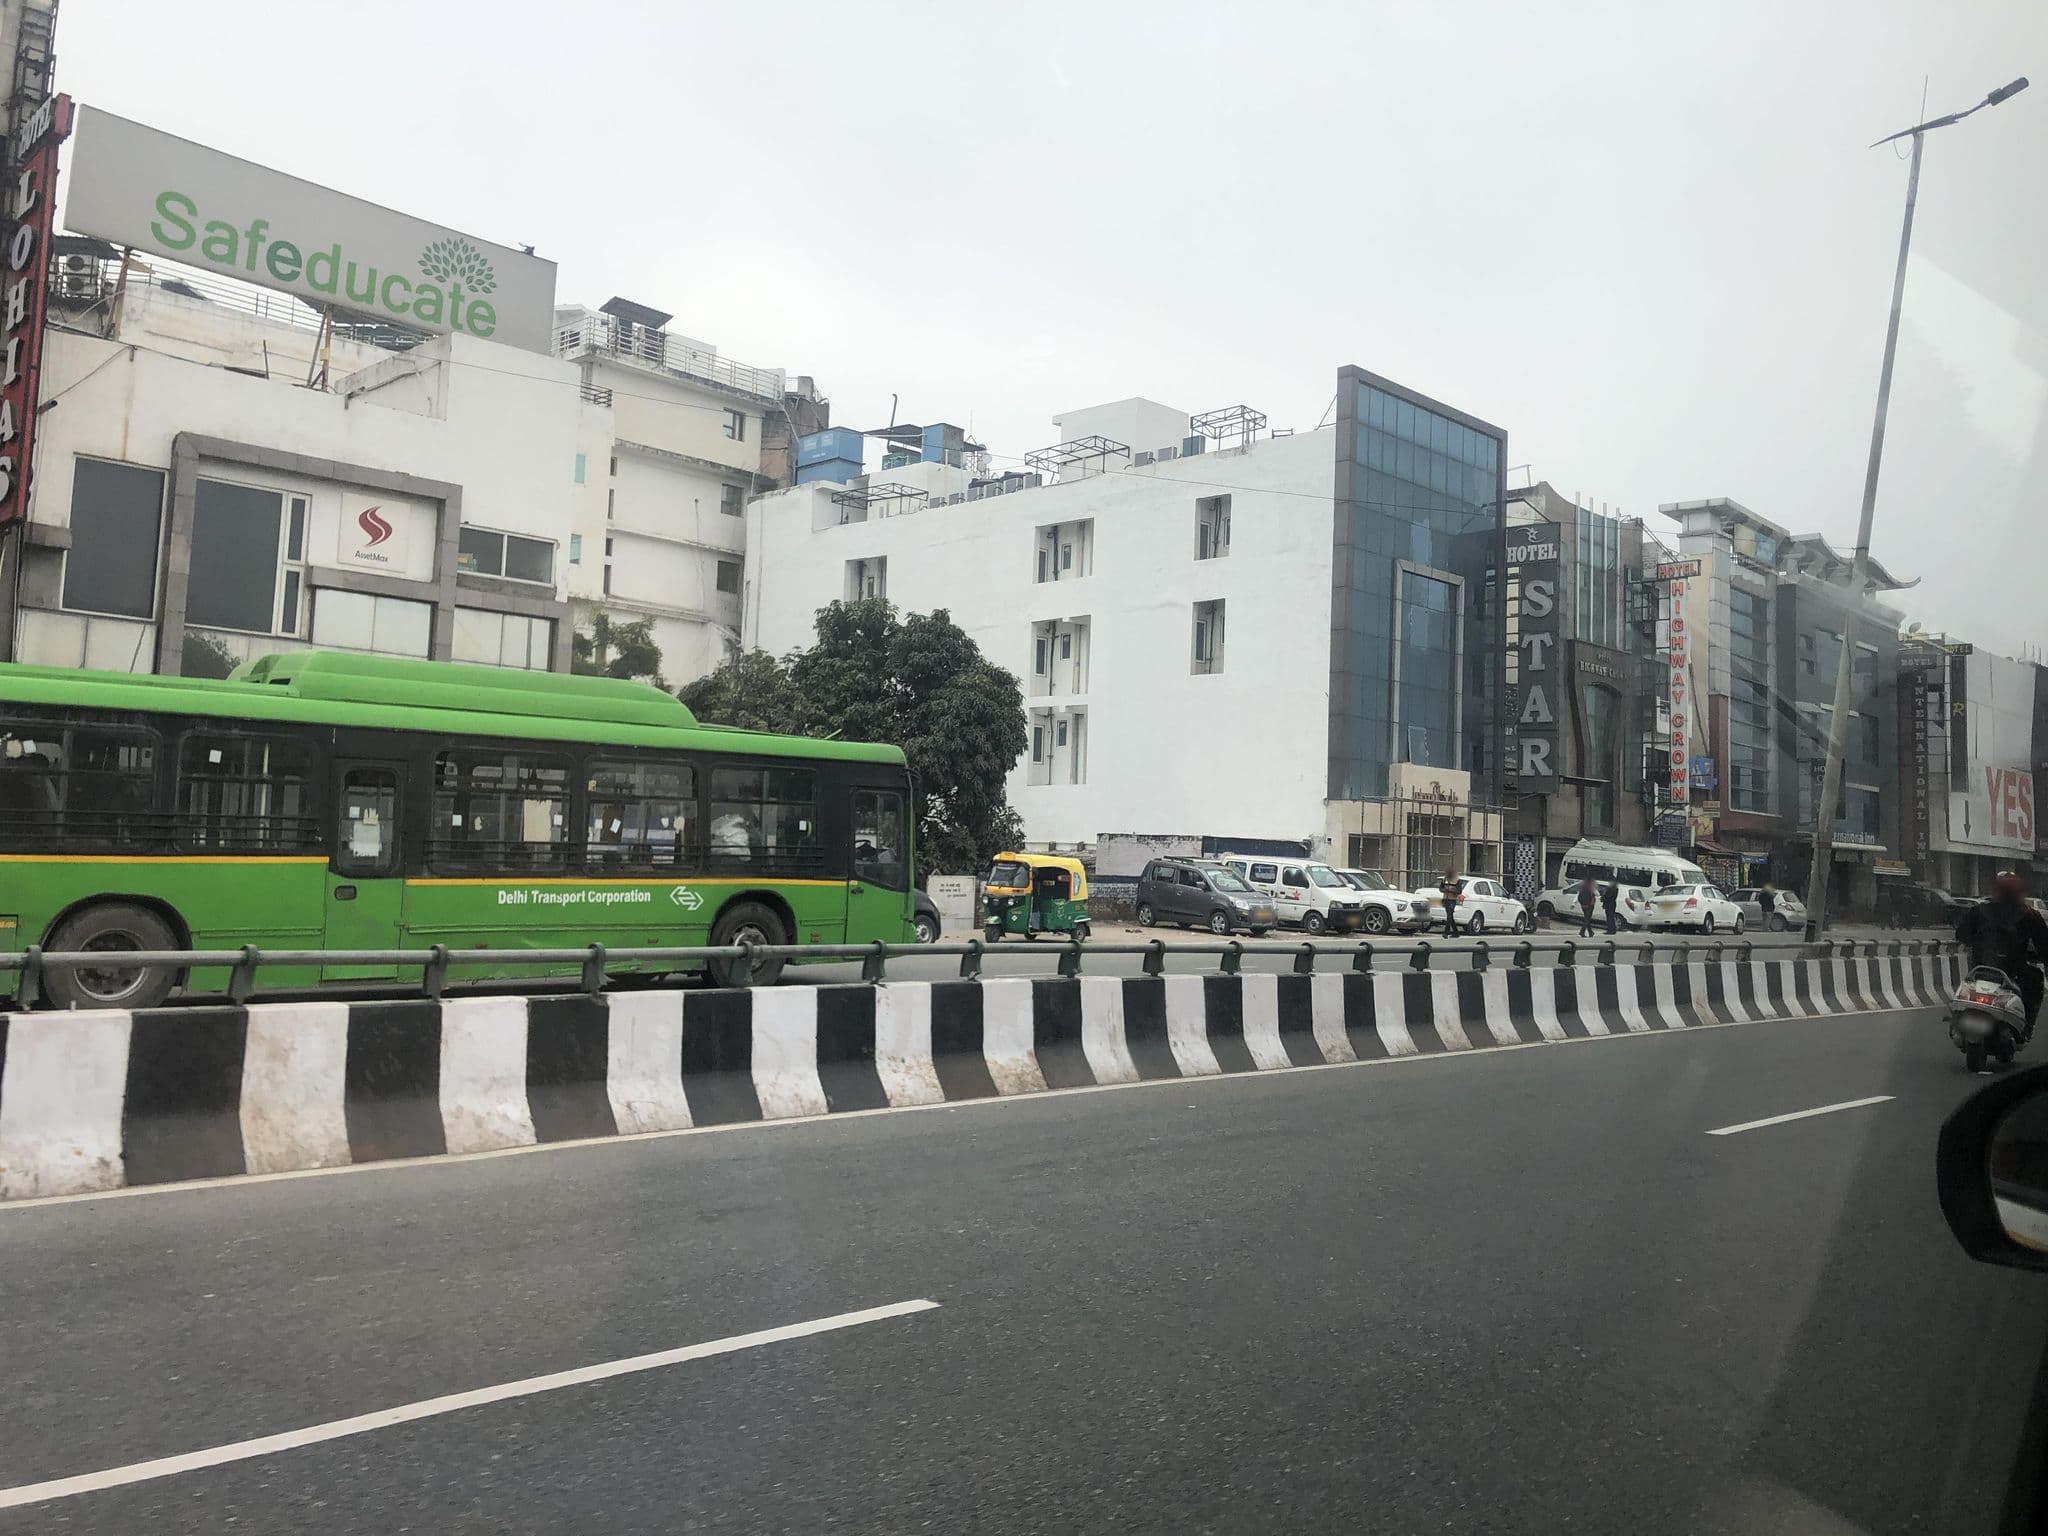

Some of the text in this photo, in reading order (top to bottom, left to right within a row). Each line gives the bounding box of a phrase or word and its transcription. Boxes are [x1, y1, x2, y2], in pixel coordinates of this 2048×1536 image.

[151, 191, 497, 337] Safeducate
[1507, 543, 1557, 563] HOTEL
[1658, 561, 1697, 578] HOTEL
[1520, 579, 1554, 777] STAR
[1671, 581, 1686, 704] HIGHWAY
[1671, 713, 1687, 801] CROWN
[1915, 675, 1927, 860] INTERNATIONAL INN
[1986, 766, 2032, 840] YES
[498, 889, 651, 906] Delhi Transport Corporation
